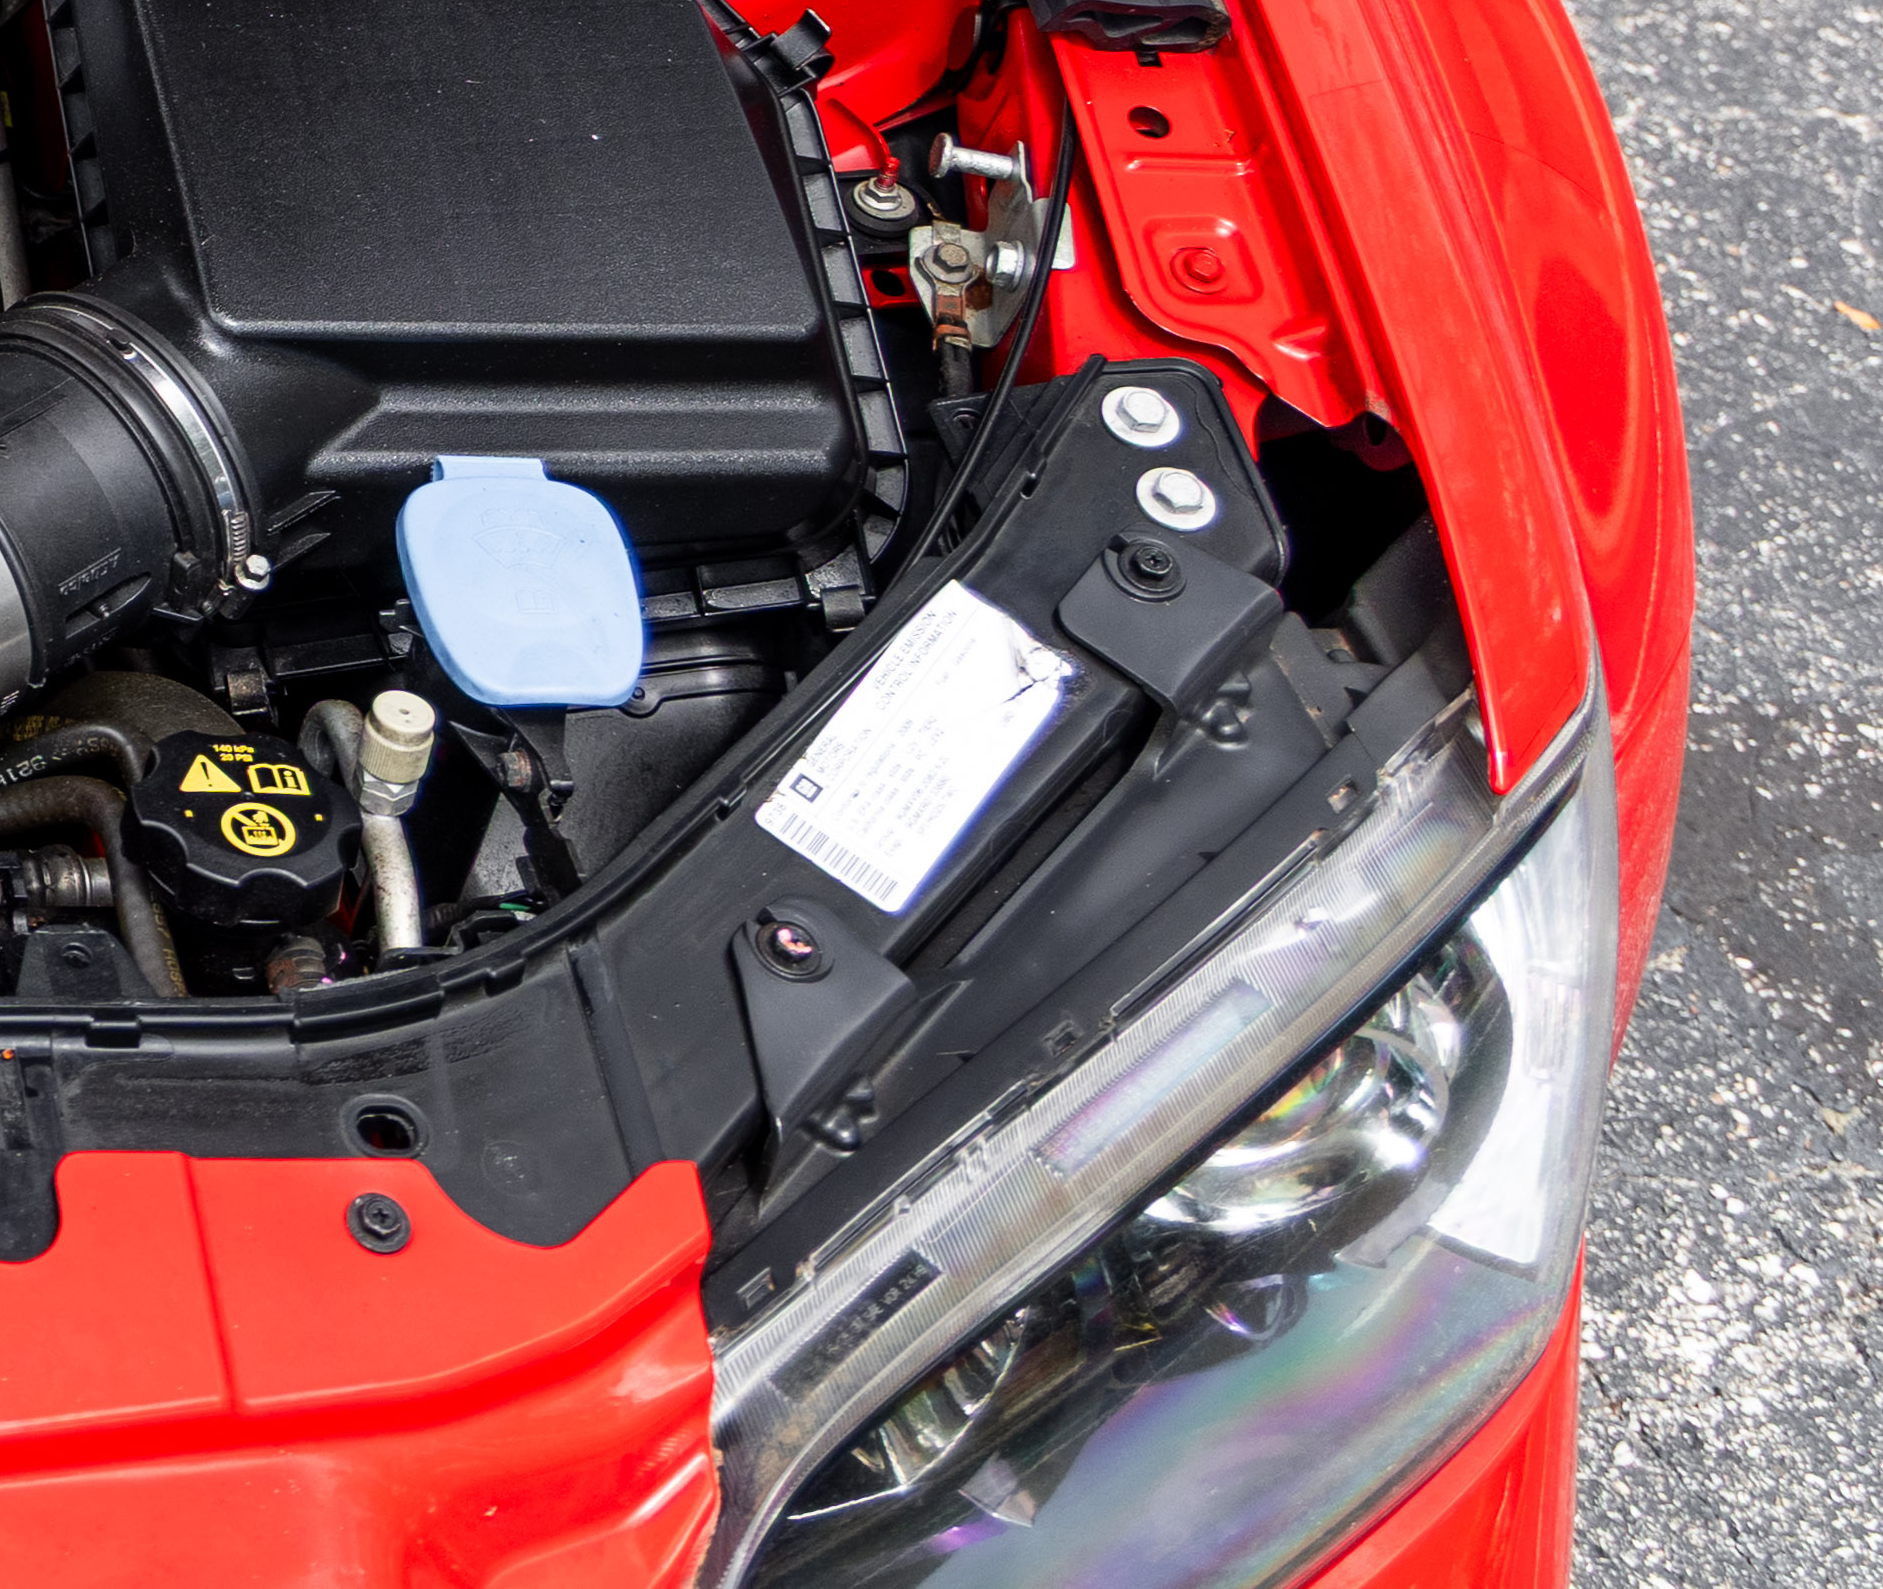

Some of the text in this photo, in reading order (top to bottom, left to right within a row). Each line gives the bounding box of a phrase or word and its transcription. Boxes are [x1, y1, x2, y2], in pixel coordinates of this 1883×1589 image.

[873, 610, 937, 691] VEHICLE EMISSION
[875, 610, 958, 711] CONTROL INFORMATION
[212, 744, 254, 753] 140 kPa
[219, 753, 253, 762] 20 PSI
[807, 733, 838, 768] GENERAL
[815, 741, 846, 774] MOTORS
[826, 727, 872, 782] CORPORATION
